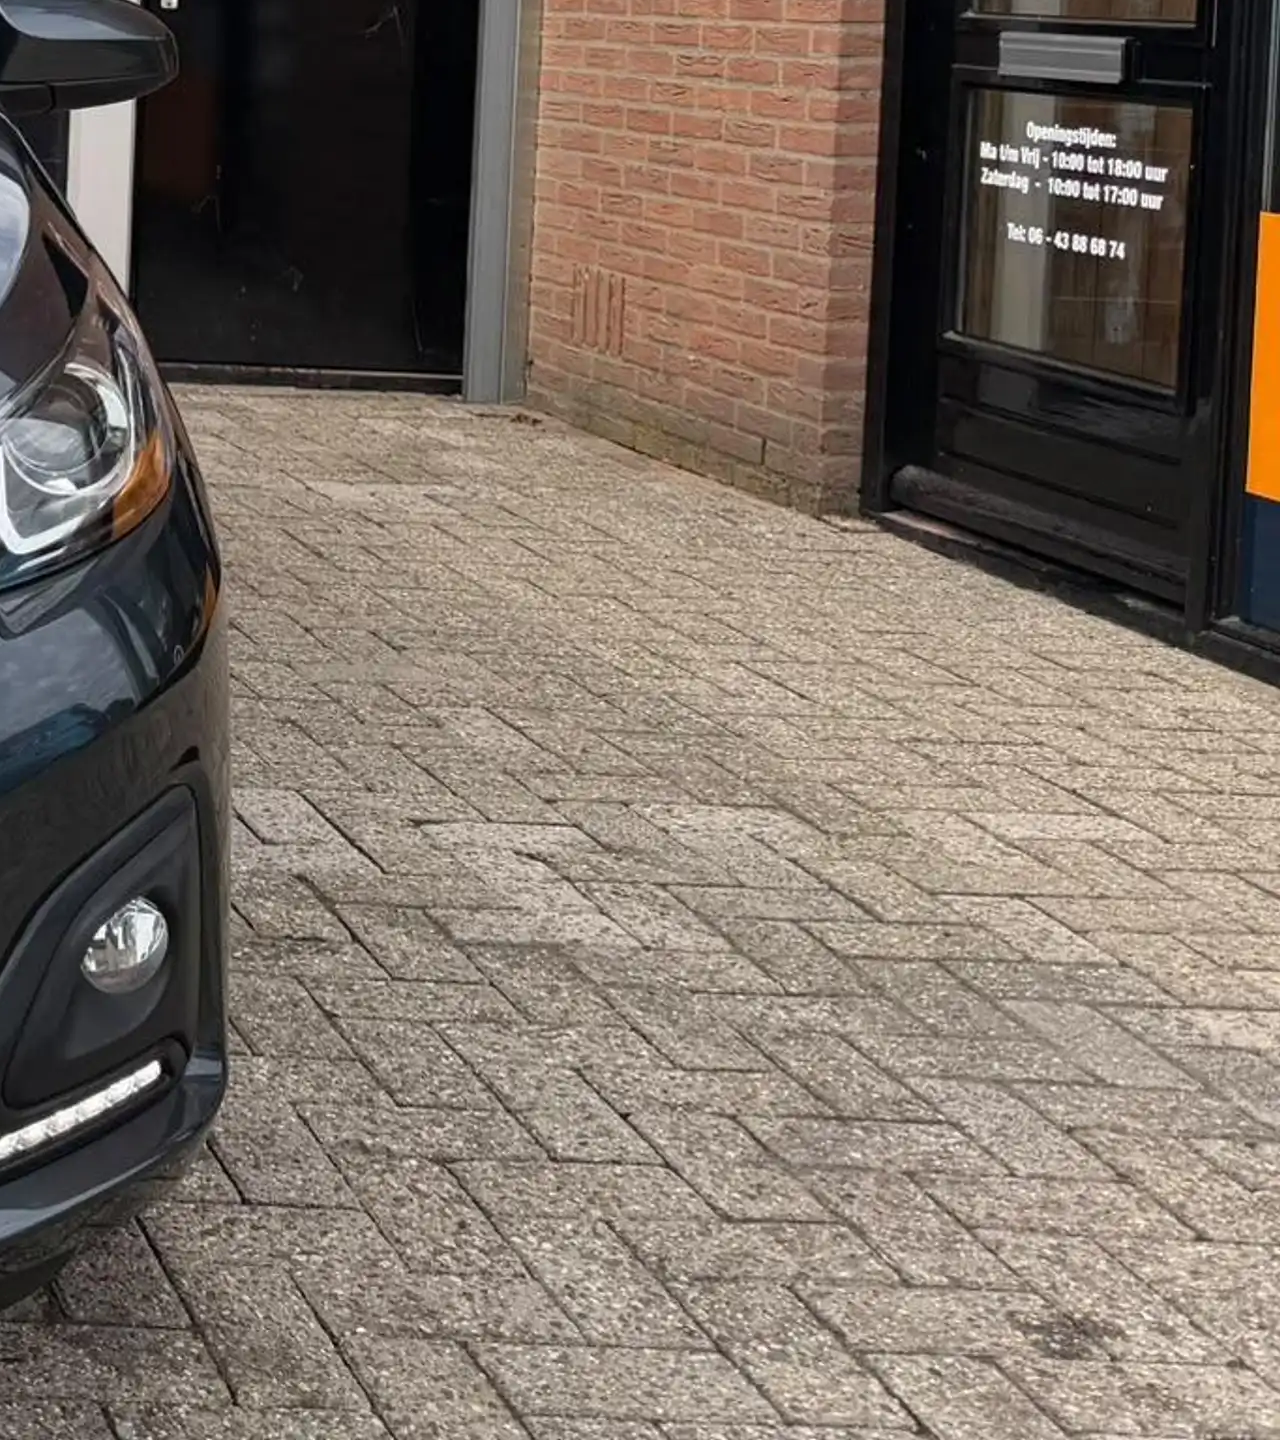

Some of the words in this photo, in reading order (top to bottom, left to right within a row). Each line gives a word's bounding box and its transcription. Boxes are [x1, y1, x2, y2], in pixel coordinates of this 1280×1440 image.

[1145, 165, 1169, 182] uur
[1103, 184, 1138, 206] 17:00
[1141, 193, 1164, 210] uur
[1054, 230, 1069, 250] 43
[1109, 240, 1125, 260] 74
